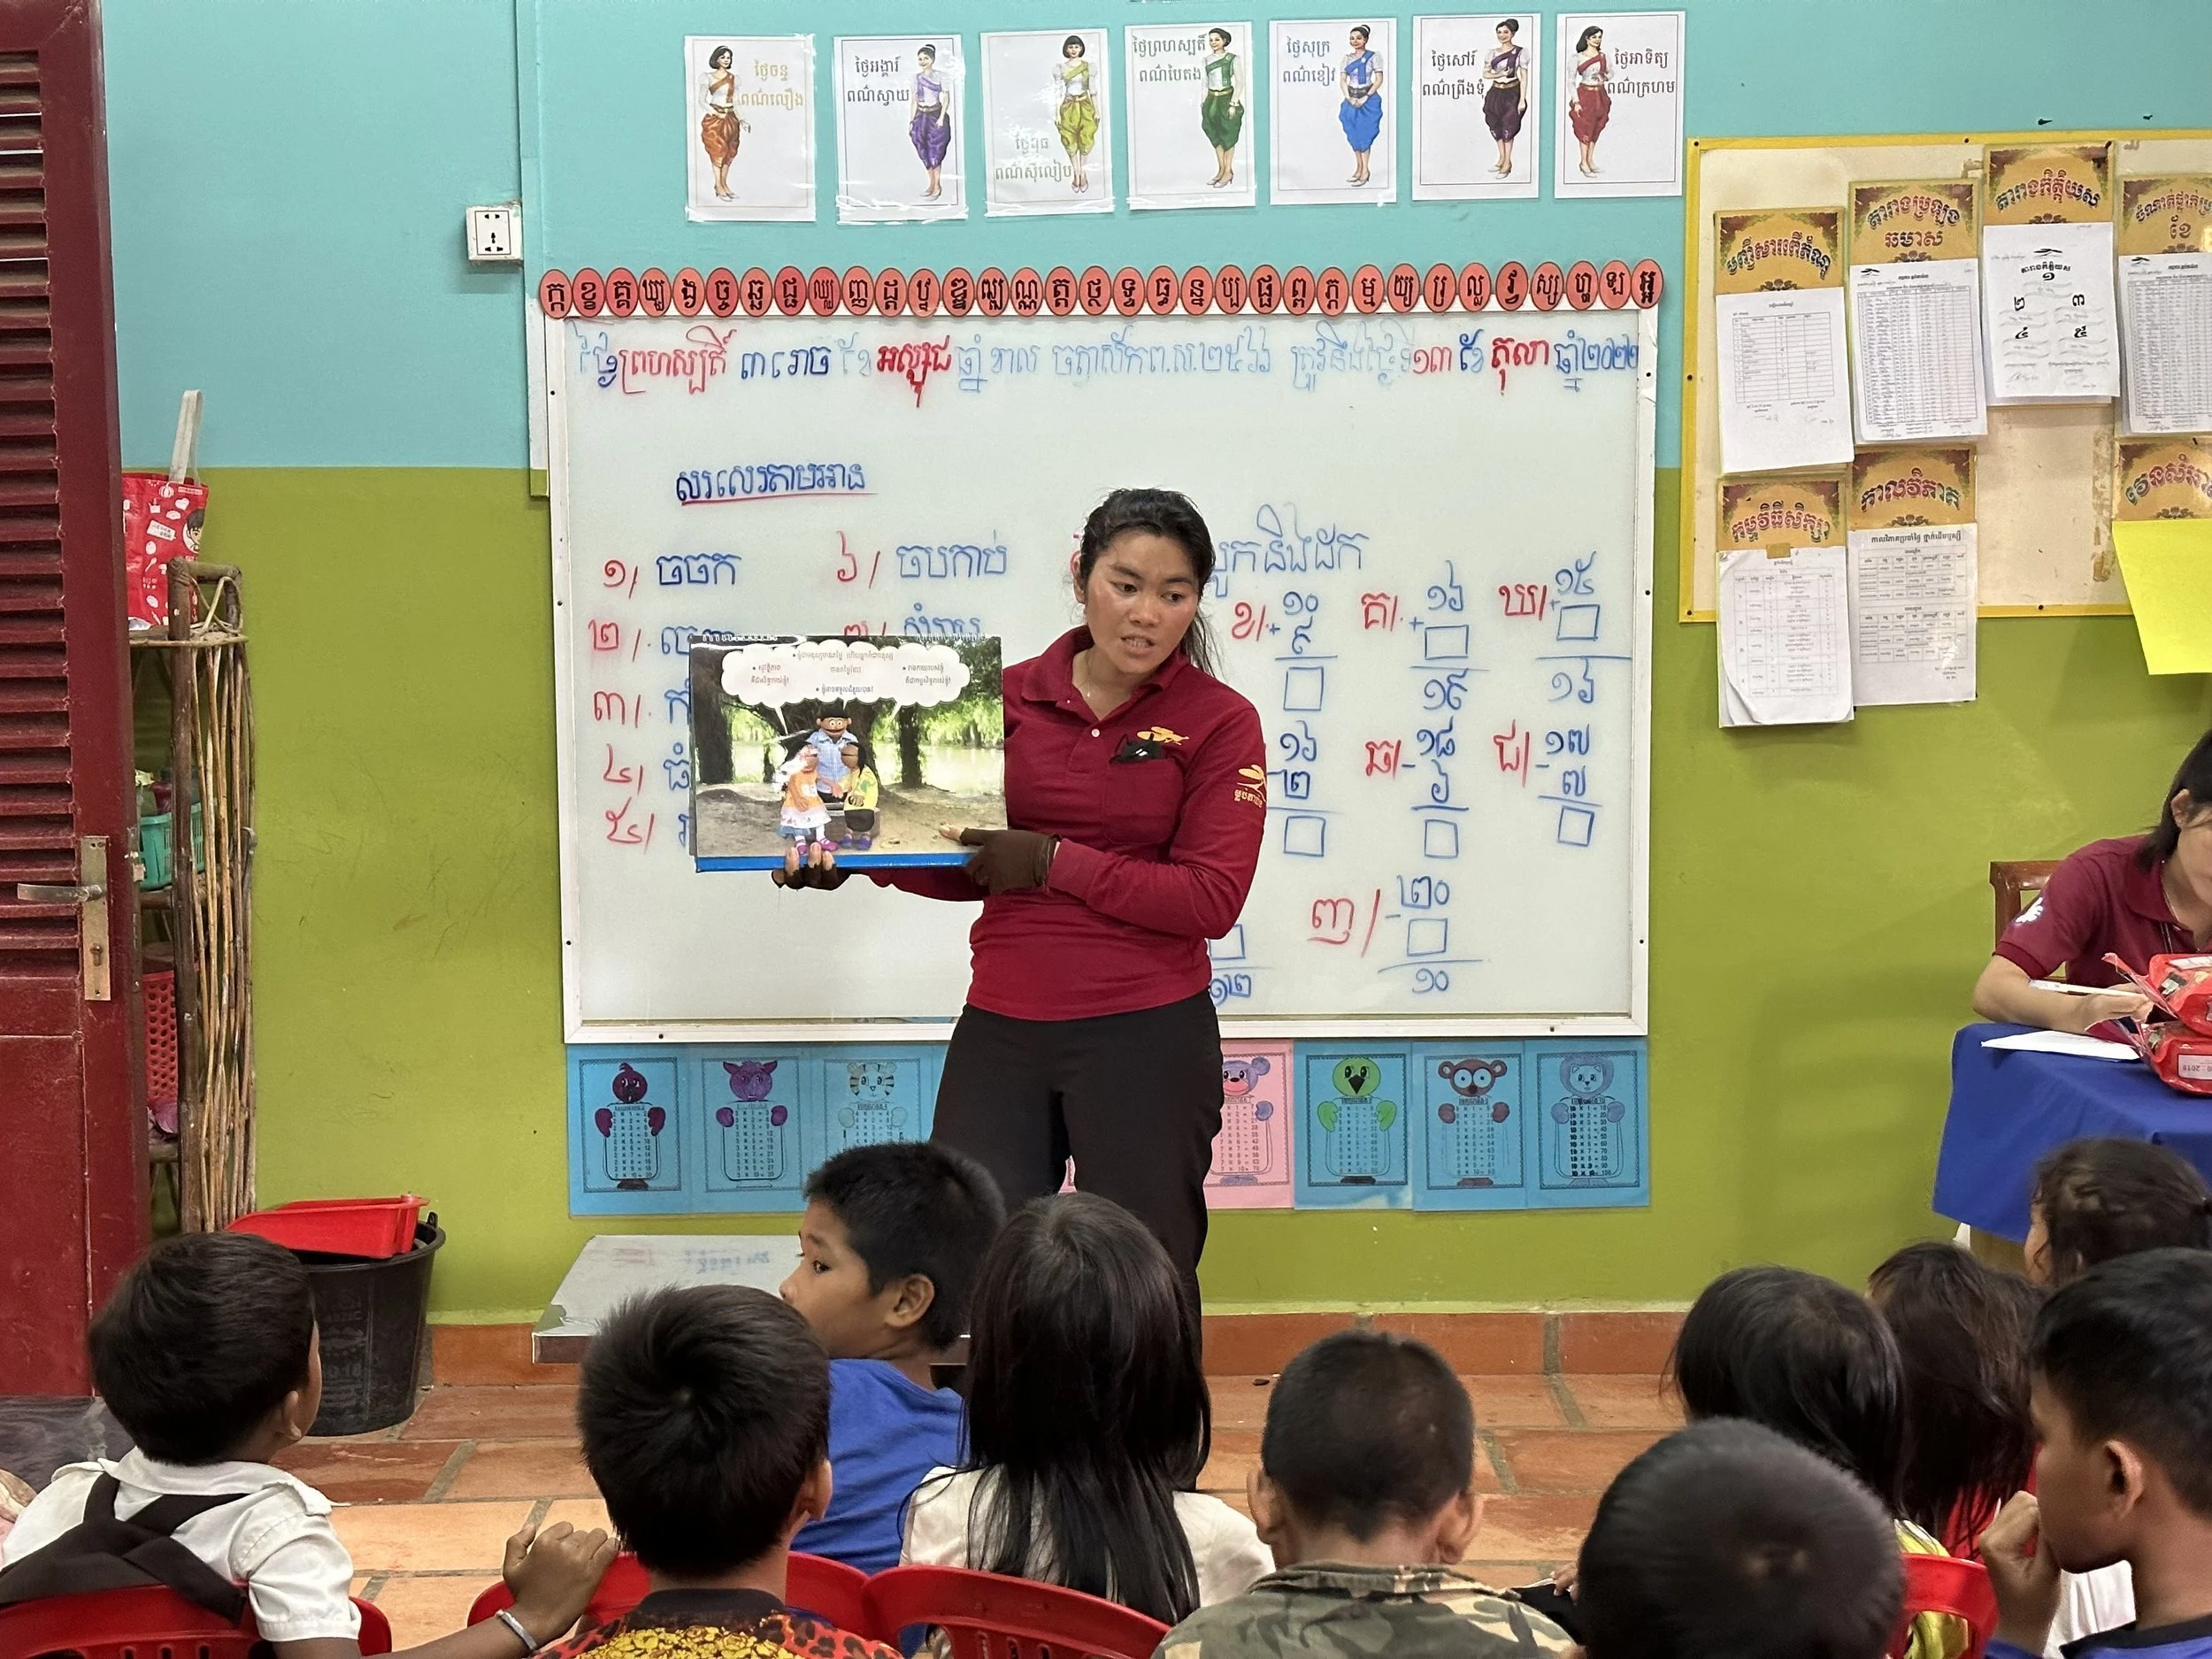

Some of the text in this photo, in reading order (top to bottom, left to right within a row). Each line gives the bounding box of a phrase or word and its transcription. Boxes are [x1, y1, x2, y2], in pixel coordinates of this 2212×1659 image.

[1286, 36, 1331, 60] ថ្ងៃសុក្រ
[1615, 46, 1670, 72] ថ្ងៃអាទិត្យ
[847, 83, 910, 108] ពណ៌ស្វាយ
[1607, 78, 1676, 99] ពណ៌ក្រហម
[2170, 215, 2191, 240] ខែ
[1606, 271, 1625, 296] ឡ
[2042, 272, 2055, 280] ១
[2014, 296, 2025, 311] ២
[2072, 294, 2085, 306] ៣
[2015, 326, 2029, 340] ៤
[2074, 326, 2087, 338] ៥
[1282, 590, 1319, 615] ១០
